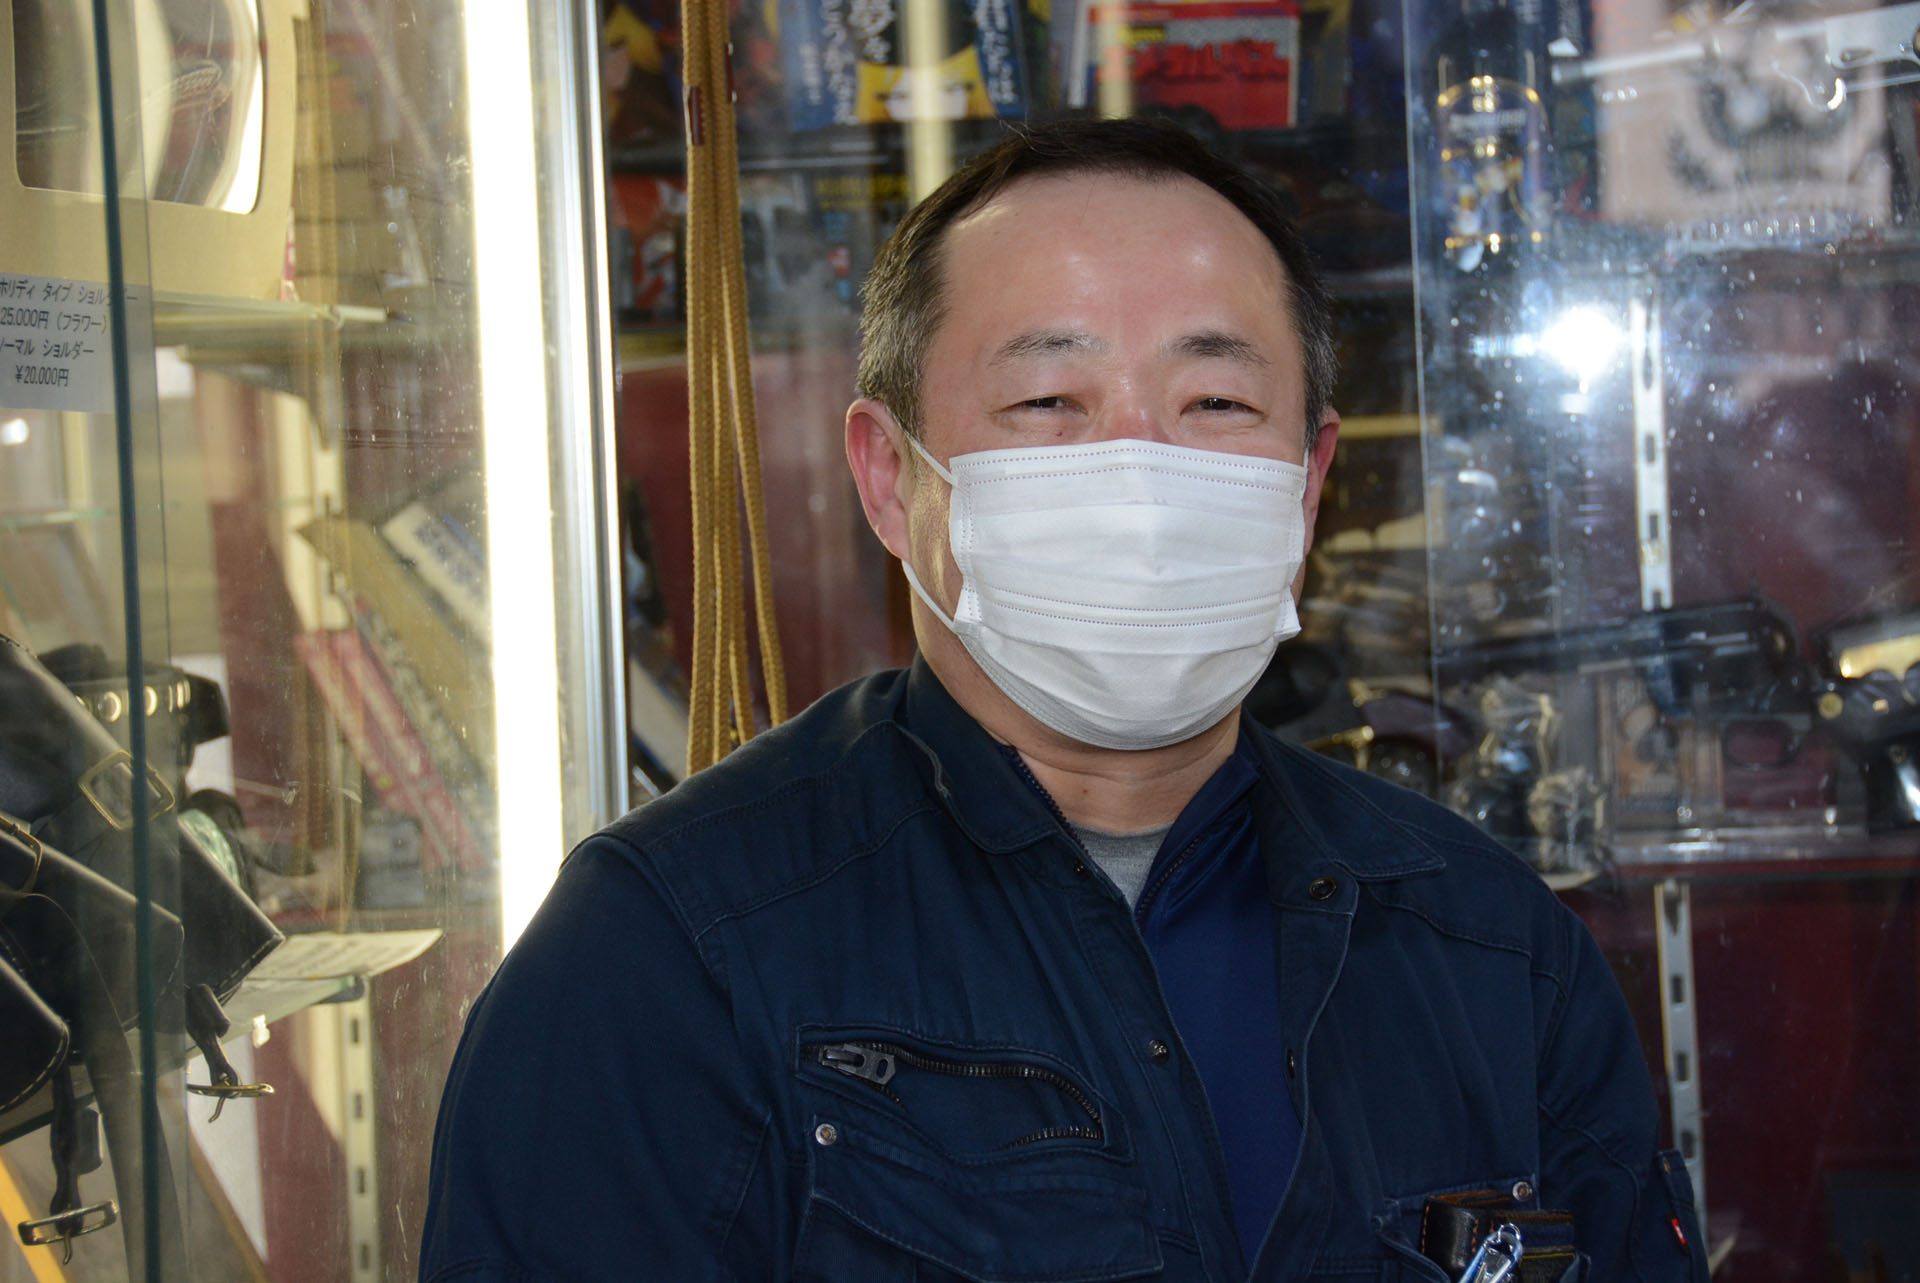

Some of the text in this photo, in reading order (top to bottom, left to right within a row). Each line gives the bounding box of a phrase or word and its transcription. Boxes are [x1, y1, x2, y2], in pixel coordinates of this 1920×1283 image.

[78, 286, 138, 306] ショルー
[43, 339, 95, 360] ショルダー
